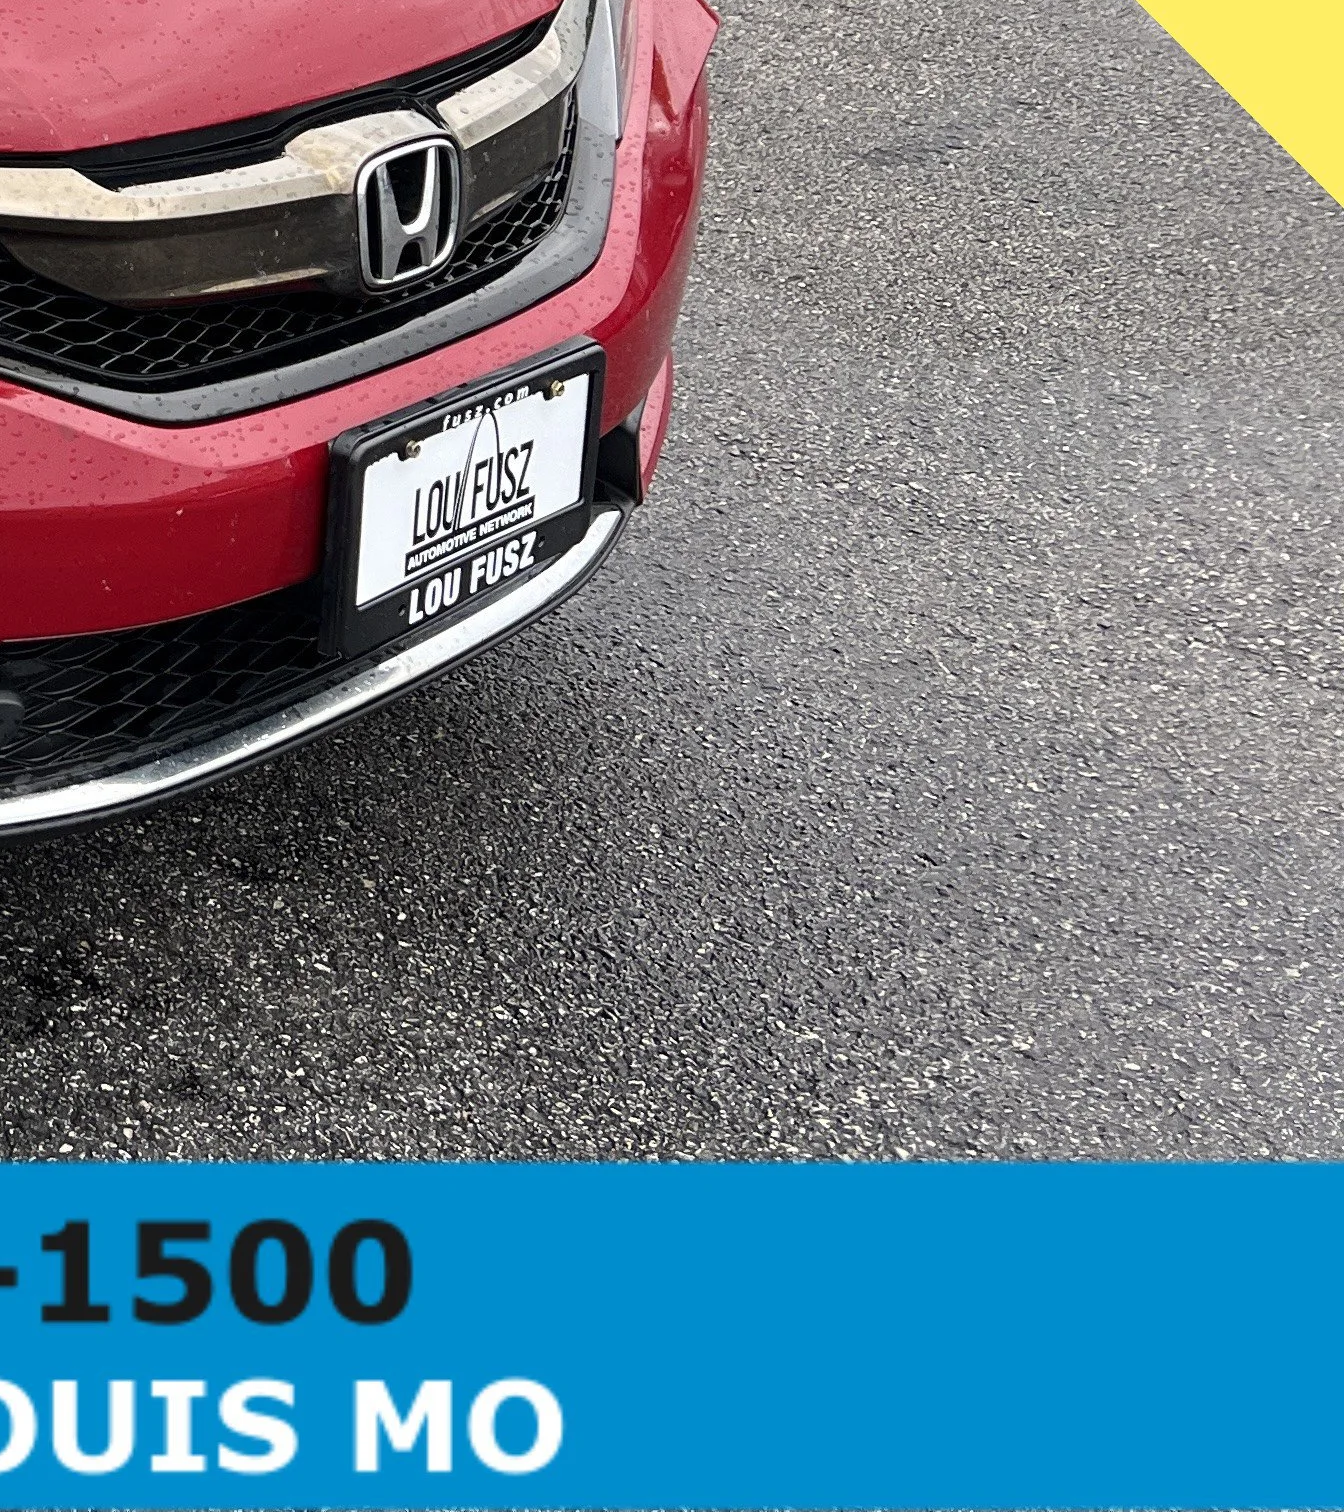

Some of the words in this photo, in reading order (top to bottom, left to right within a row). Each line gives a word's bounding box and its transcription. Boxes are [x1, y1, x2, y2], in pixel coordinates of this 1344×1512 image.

[442, 385, 530, 432] fusz.com
[413, 470, 461, 546] LOU
[471, 438, 534, 519] FUSZ
[407, 527, 478, 571] AUTOMOTIVE
[479, 502, 532, 536] NETWORK
[408, 567, 462, 625] LOU
[469, 530, 537, 594] FUSZ
